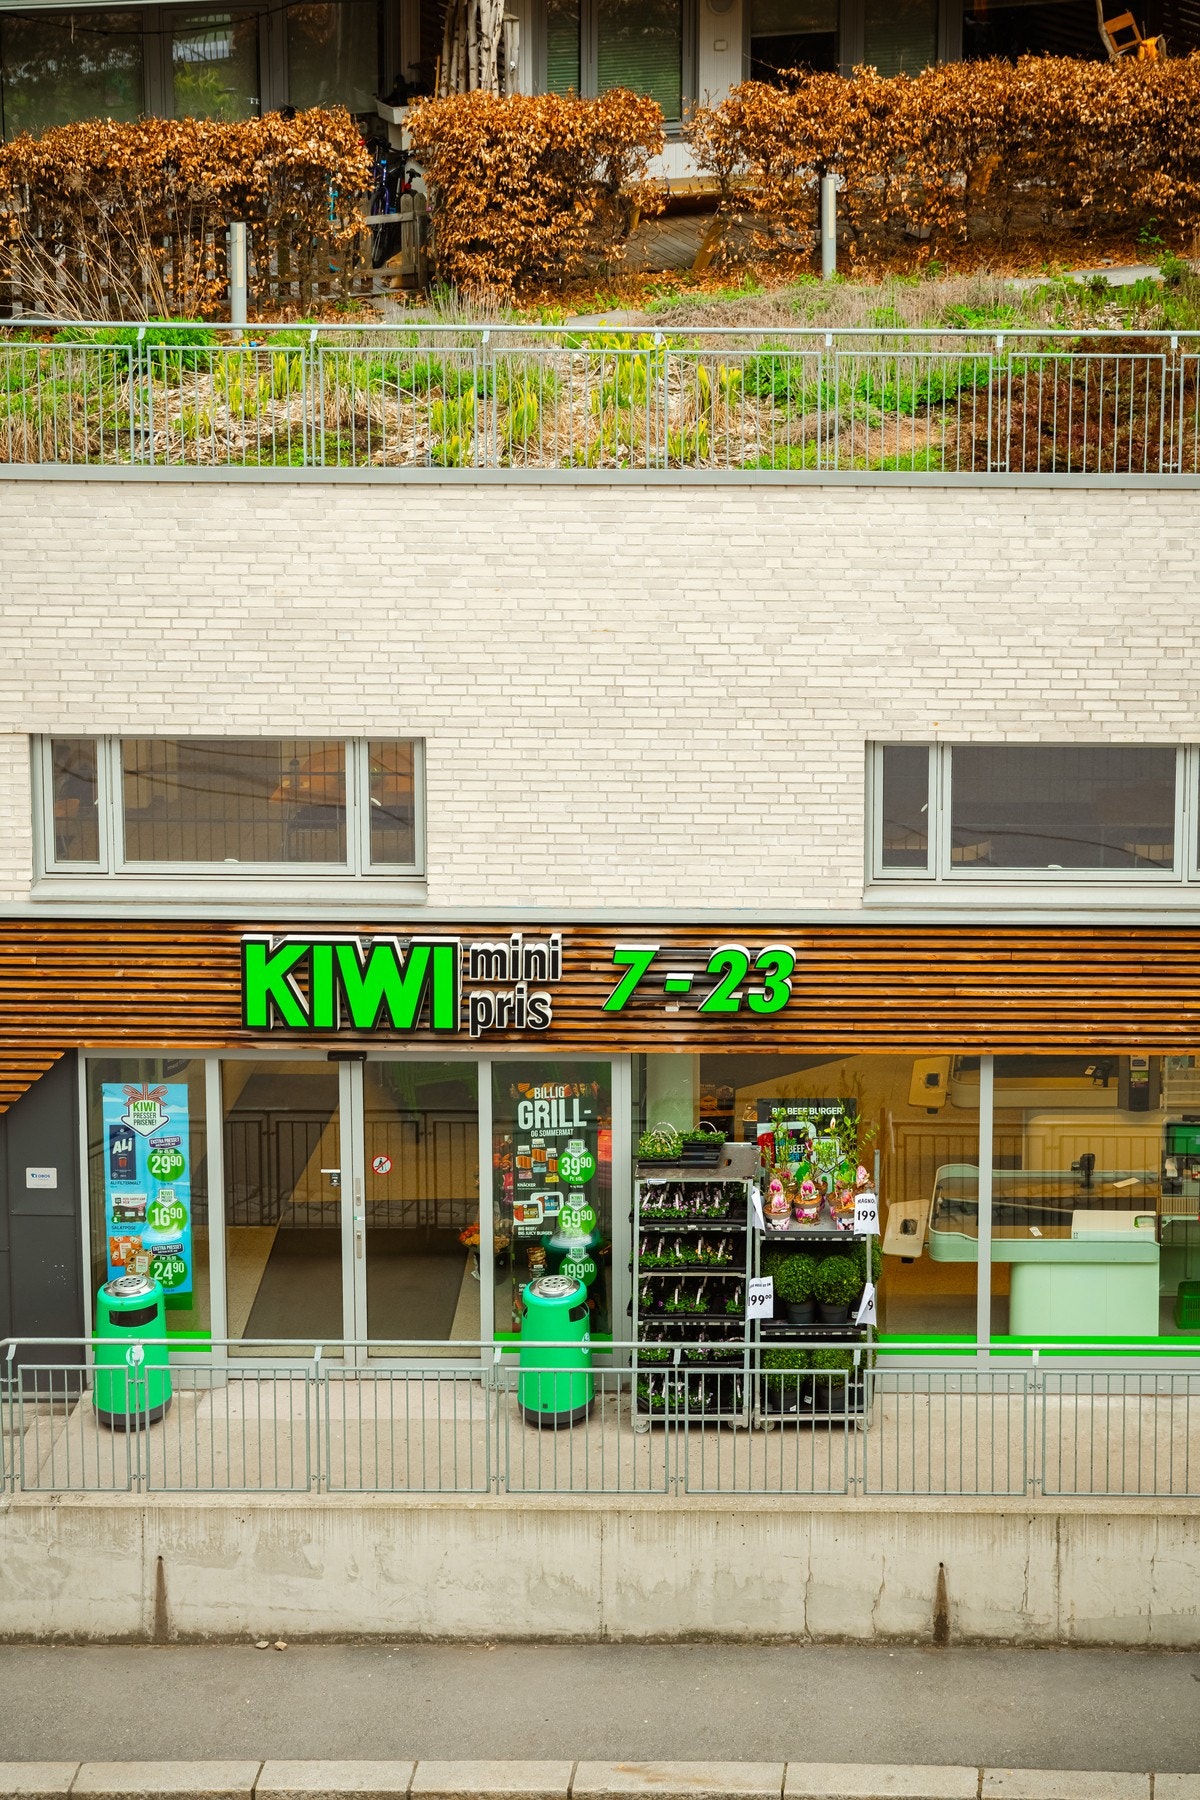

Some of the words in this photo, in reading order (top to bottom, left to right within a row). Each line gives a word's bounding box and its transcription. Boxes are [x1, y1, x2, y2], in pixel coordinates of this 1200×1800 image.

[470, 934, 562, 980] mini
[241, 935, 461, 1032] KIWI
[601, 945, 660, 1011] 7
[698, 944, 796, 1014] 23
[469, 982, 552, 1037] pris
[534, 1086, 565, 1099] BILLIG
[133, 1102, 156, 1111] KIWI
[518, 1098, 591, 1130] GRILL-
[809, 1107, 843, 1115] BURGER
[530, 1130, 539, 1138] OG
[539, 1129, 574, 1137] SOMMERMAT
[857, 1210, 876, 1221] 199
